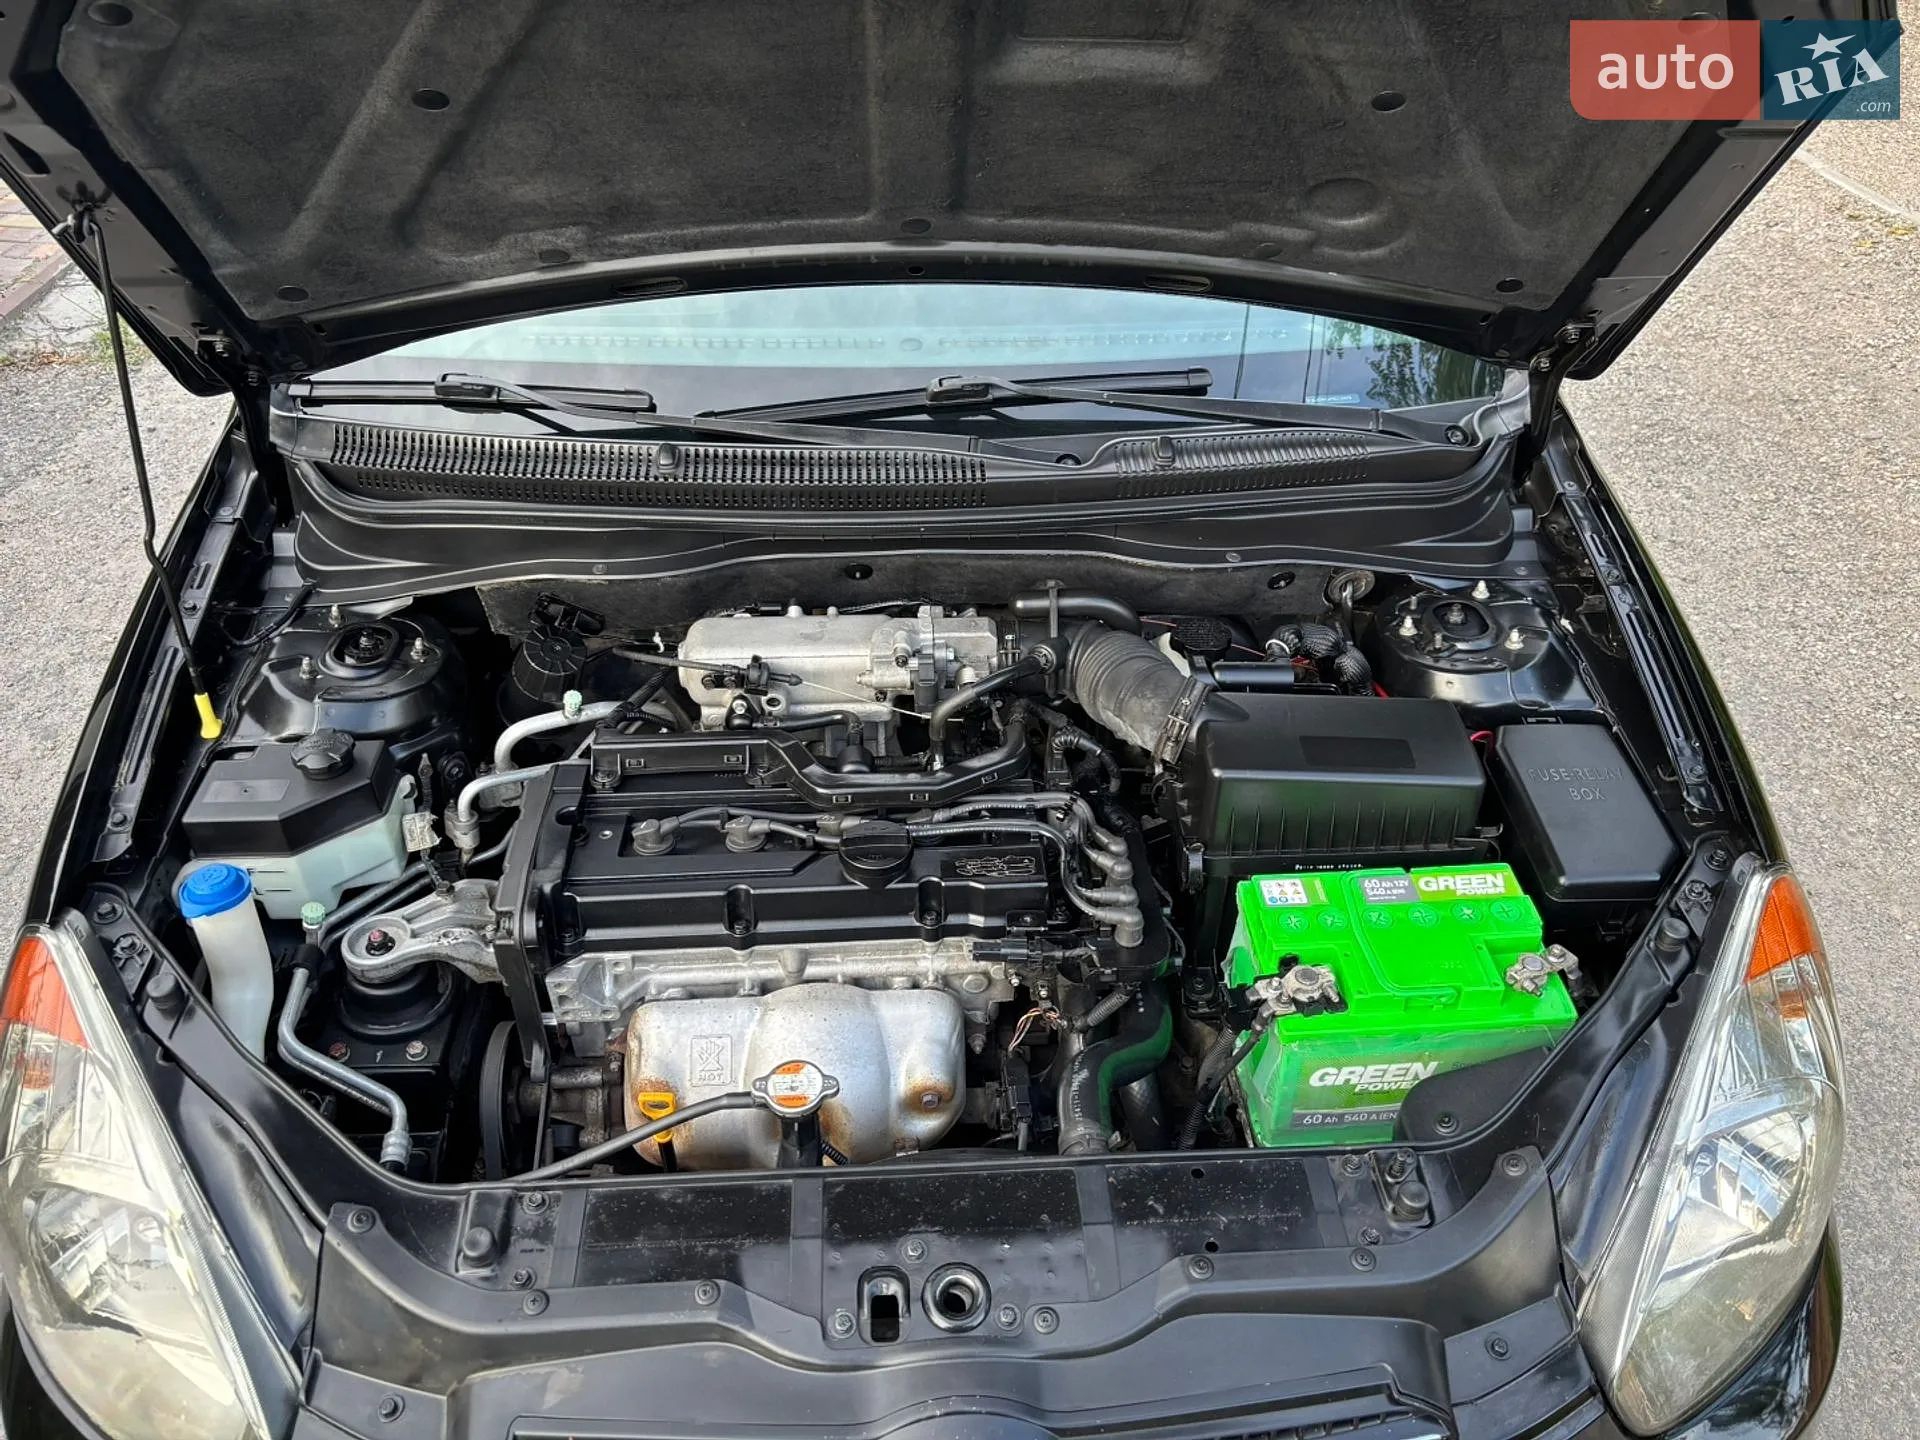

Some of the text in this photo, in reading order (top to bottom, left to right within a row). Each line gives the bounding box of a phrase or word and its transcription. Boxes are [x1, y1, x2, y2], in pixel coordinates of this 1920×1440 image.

[1528, 767, 1623, 783] FUSE-RELAY
[1568, 786, 1605, 801] BOX
[1364, 878, 1380, 888] 60
[1381, 880, 1394, 888] Ah
[1418, 872, 1505, 892] GREEN
[1456, 887, 1505, 896] POWER
[1309, 1061, 1439, 1087] GREEN
[1303, 1114, 1322, 1125] 60
[1324, 1115, 1339, 1124] Ah
[1343, 1113, 1368, 1123] 540
